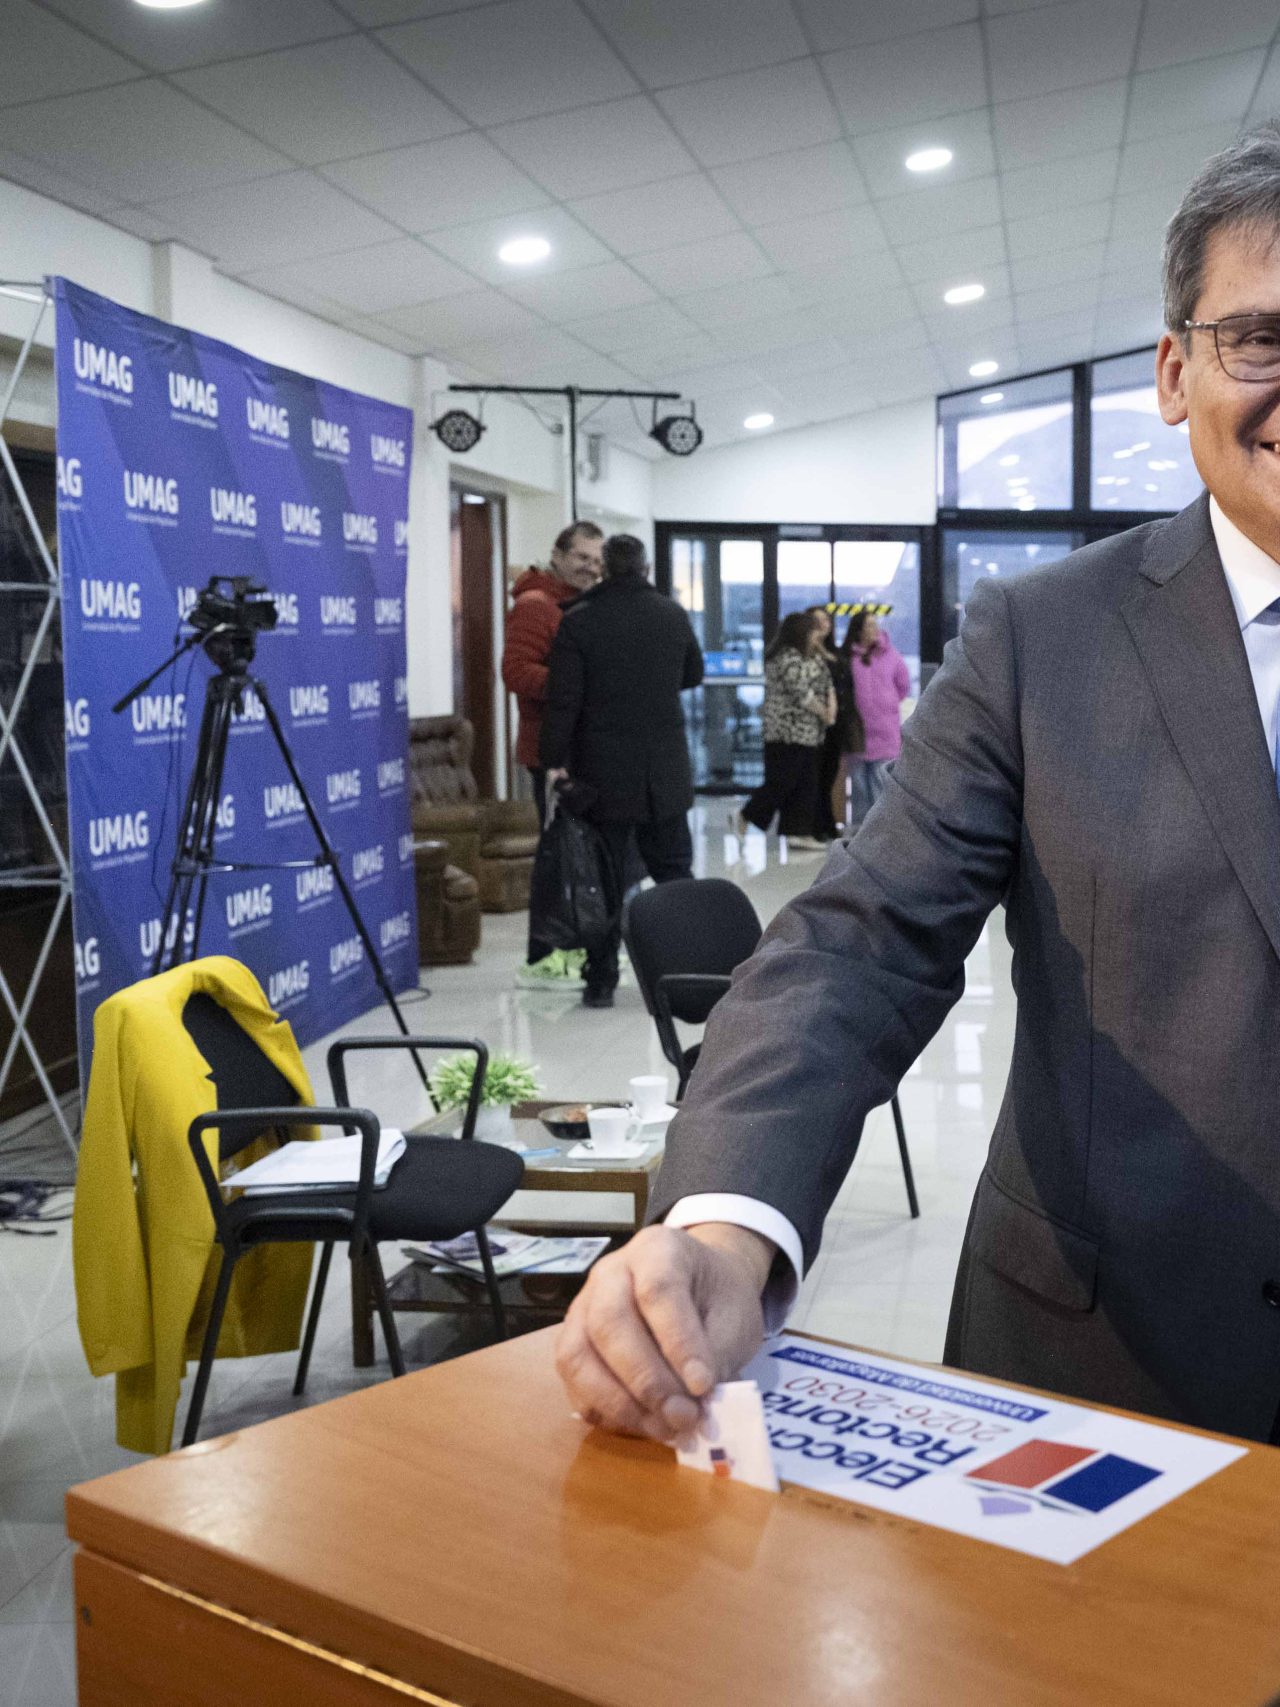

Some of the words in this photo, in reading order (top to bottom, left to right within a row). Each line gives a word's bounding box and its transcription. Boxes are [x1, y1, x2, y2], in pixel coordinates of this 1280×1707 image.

[73, 337, 134, 393] UMAG
[169, 372, 219, 418] UMAG
[247, 398, 290, 440] UMAG
[312, 419, 351, 455] UMAG
[371, 436, 405, 467] UMAG
[124, 471, 179, 515] UMAG
[211, 488, 257, 527] UMAG
[282, 503, 322, 537] UMAG
[343, 514, 378, 544] UMAG
[81, 579, 141, 619] UMAG
[321, 597, 356, 625] UMAG
[375, 599, 402, 624] UMAG
[132, 694, 187, 732] UMAG
[290, 685, 329, 717] UMAG
[350, 681, 381, 710] UMAG
[327, 770, 361, 803] UMAG
[378, 759, 404, 789] UMAG
[89, 810, 149, 856] UMAG
[353, 846, 384, 881] UMAG
[295, 865, 334, 902] UMAG
[225, 883, 273, 927] UMAG
[381, 912, 409, 948] UMAG
[330, 936, 363, 974] UMAG
[268, 959, 310, 1005] UMAG
[784, 1376, 1012, 1441] 2026-2030
[768, 1429, 931, 1490] Elecci
